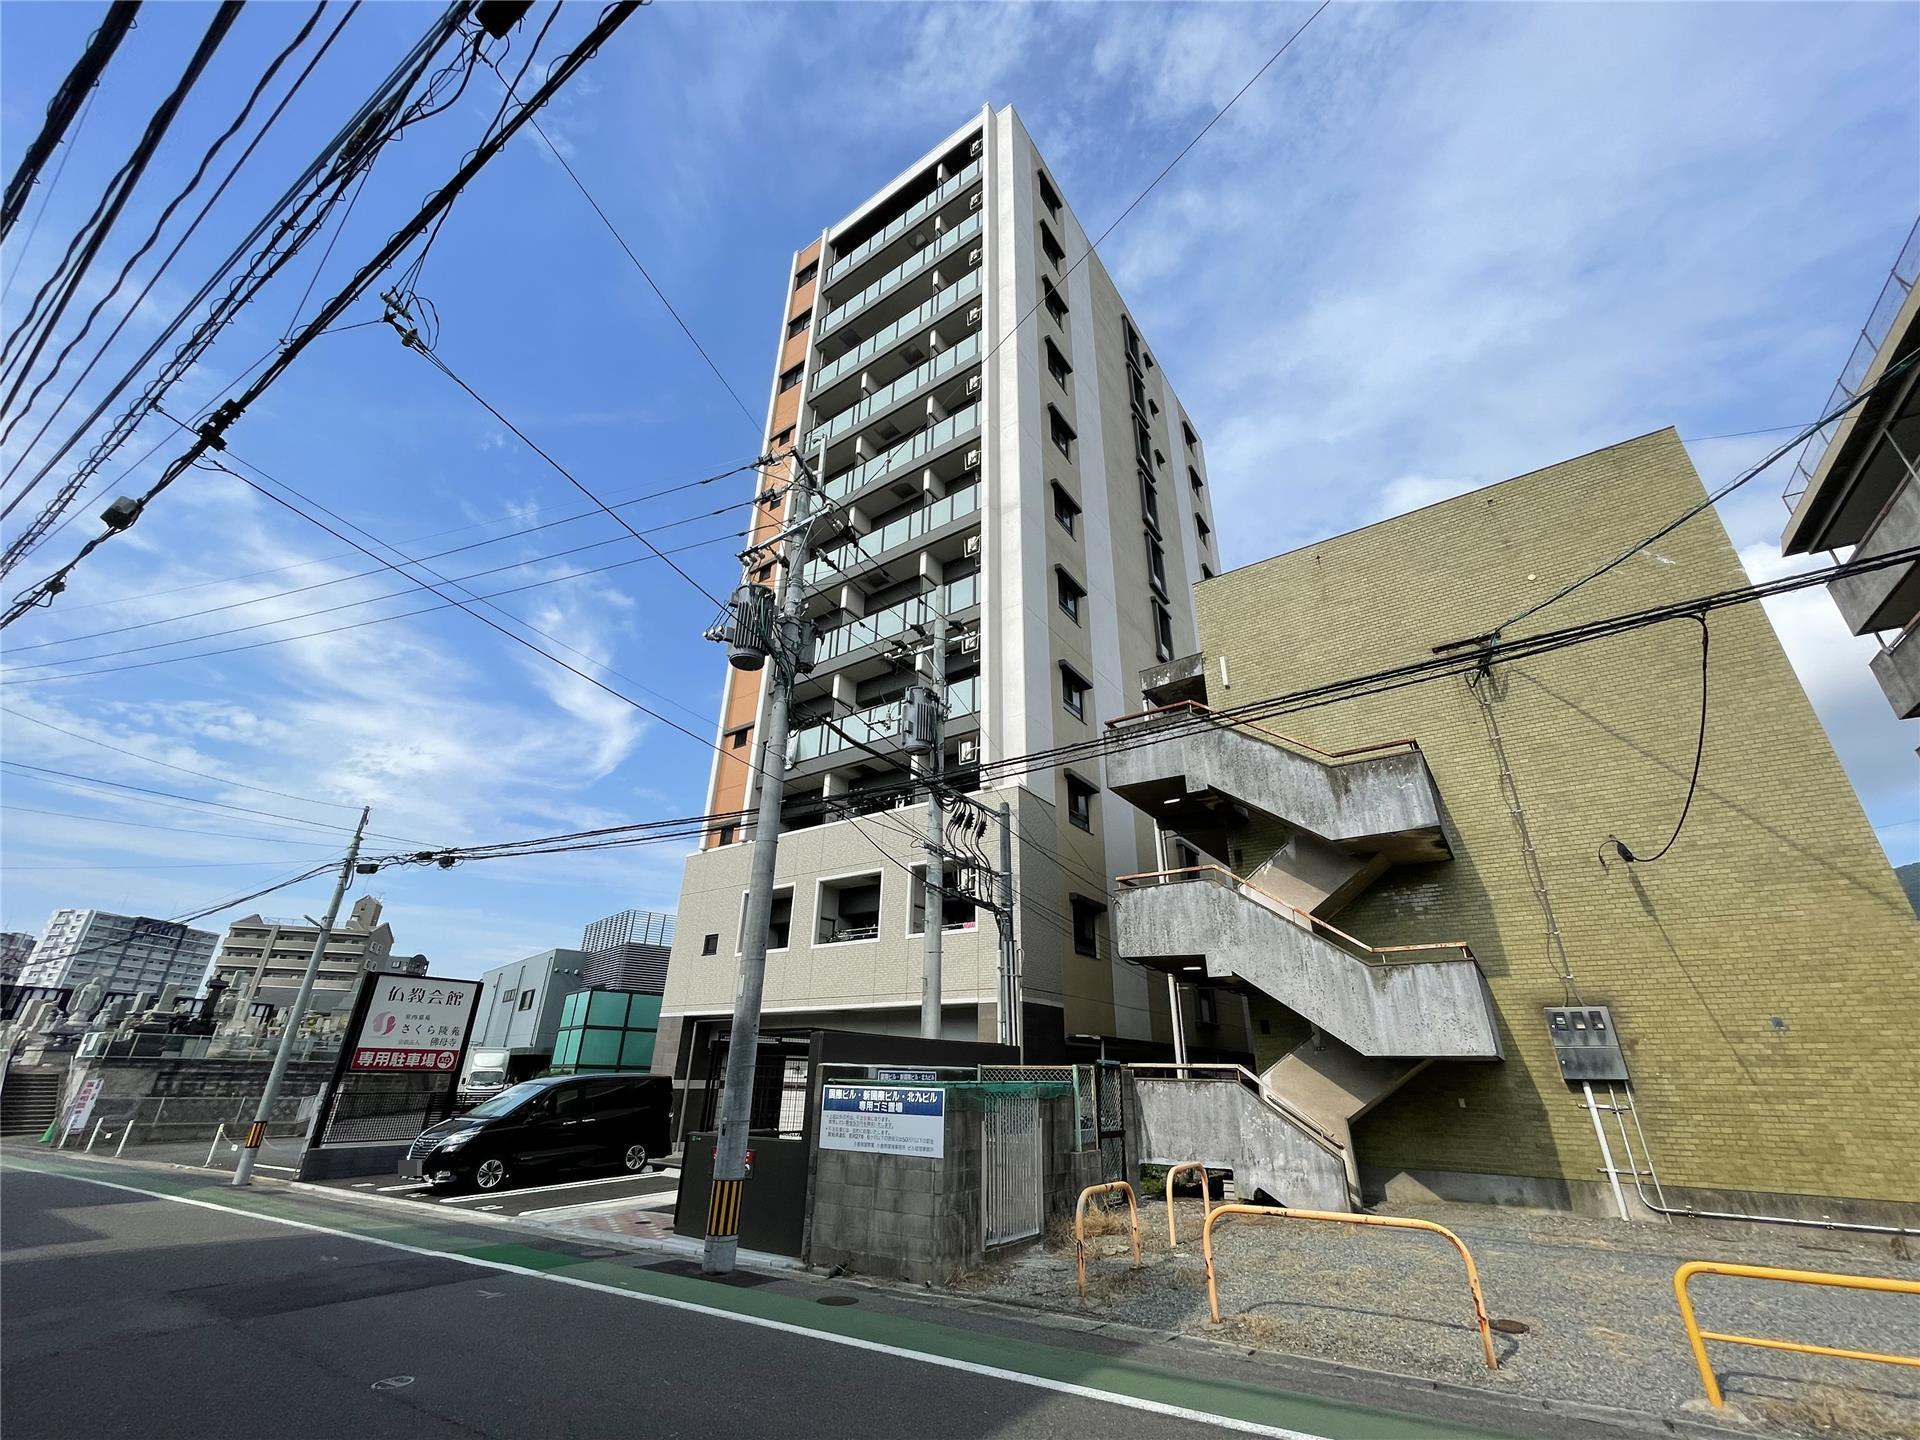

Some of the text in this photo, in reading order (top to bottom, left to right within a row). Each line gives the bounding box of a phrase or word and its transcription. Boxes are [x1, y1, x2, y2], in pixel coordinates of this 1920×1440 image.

[388, 986, 464, 1006] 仏教会館
[357, 1051, 436, 1068] 専用駐車場
